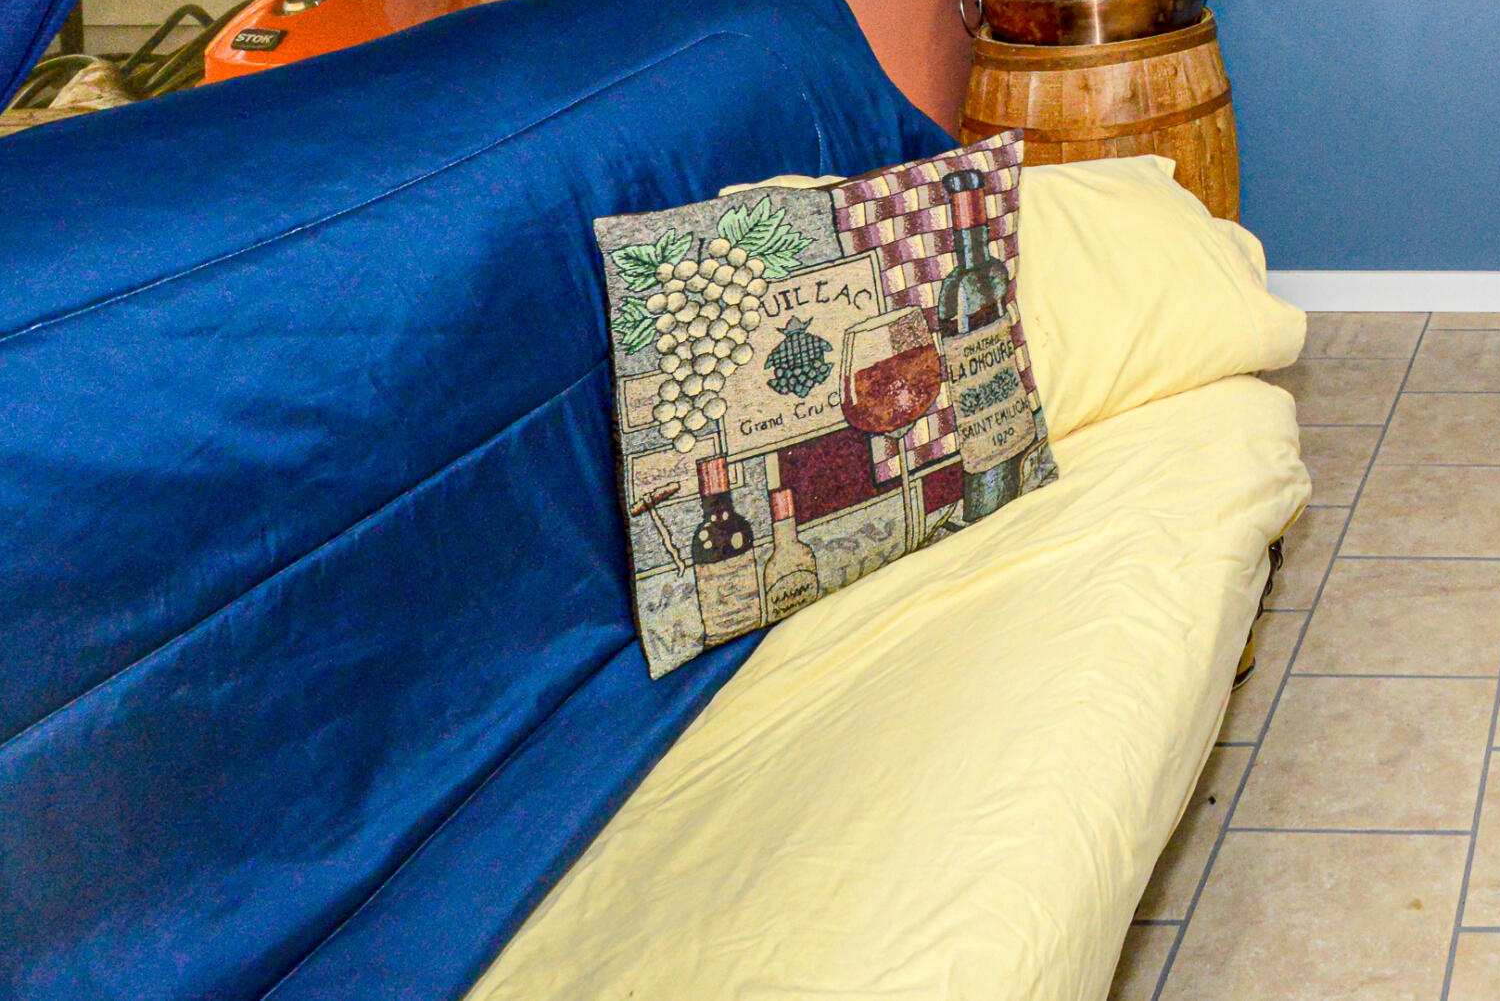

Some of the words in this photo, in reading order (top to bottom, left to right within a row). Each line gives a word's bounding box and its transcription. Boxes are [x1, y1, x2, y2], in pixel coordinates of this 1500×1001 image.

[235, 33, 274, 44] STOK
[740, 413, 783, 435] Grand
[794, 402, 824, 419] Cru
